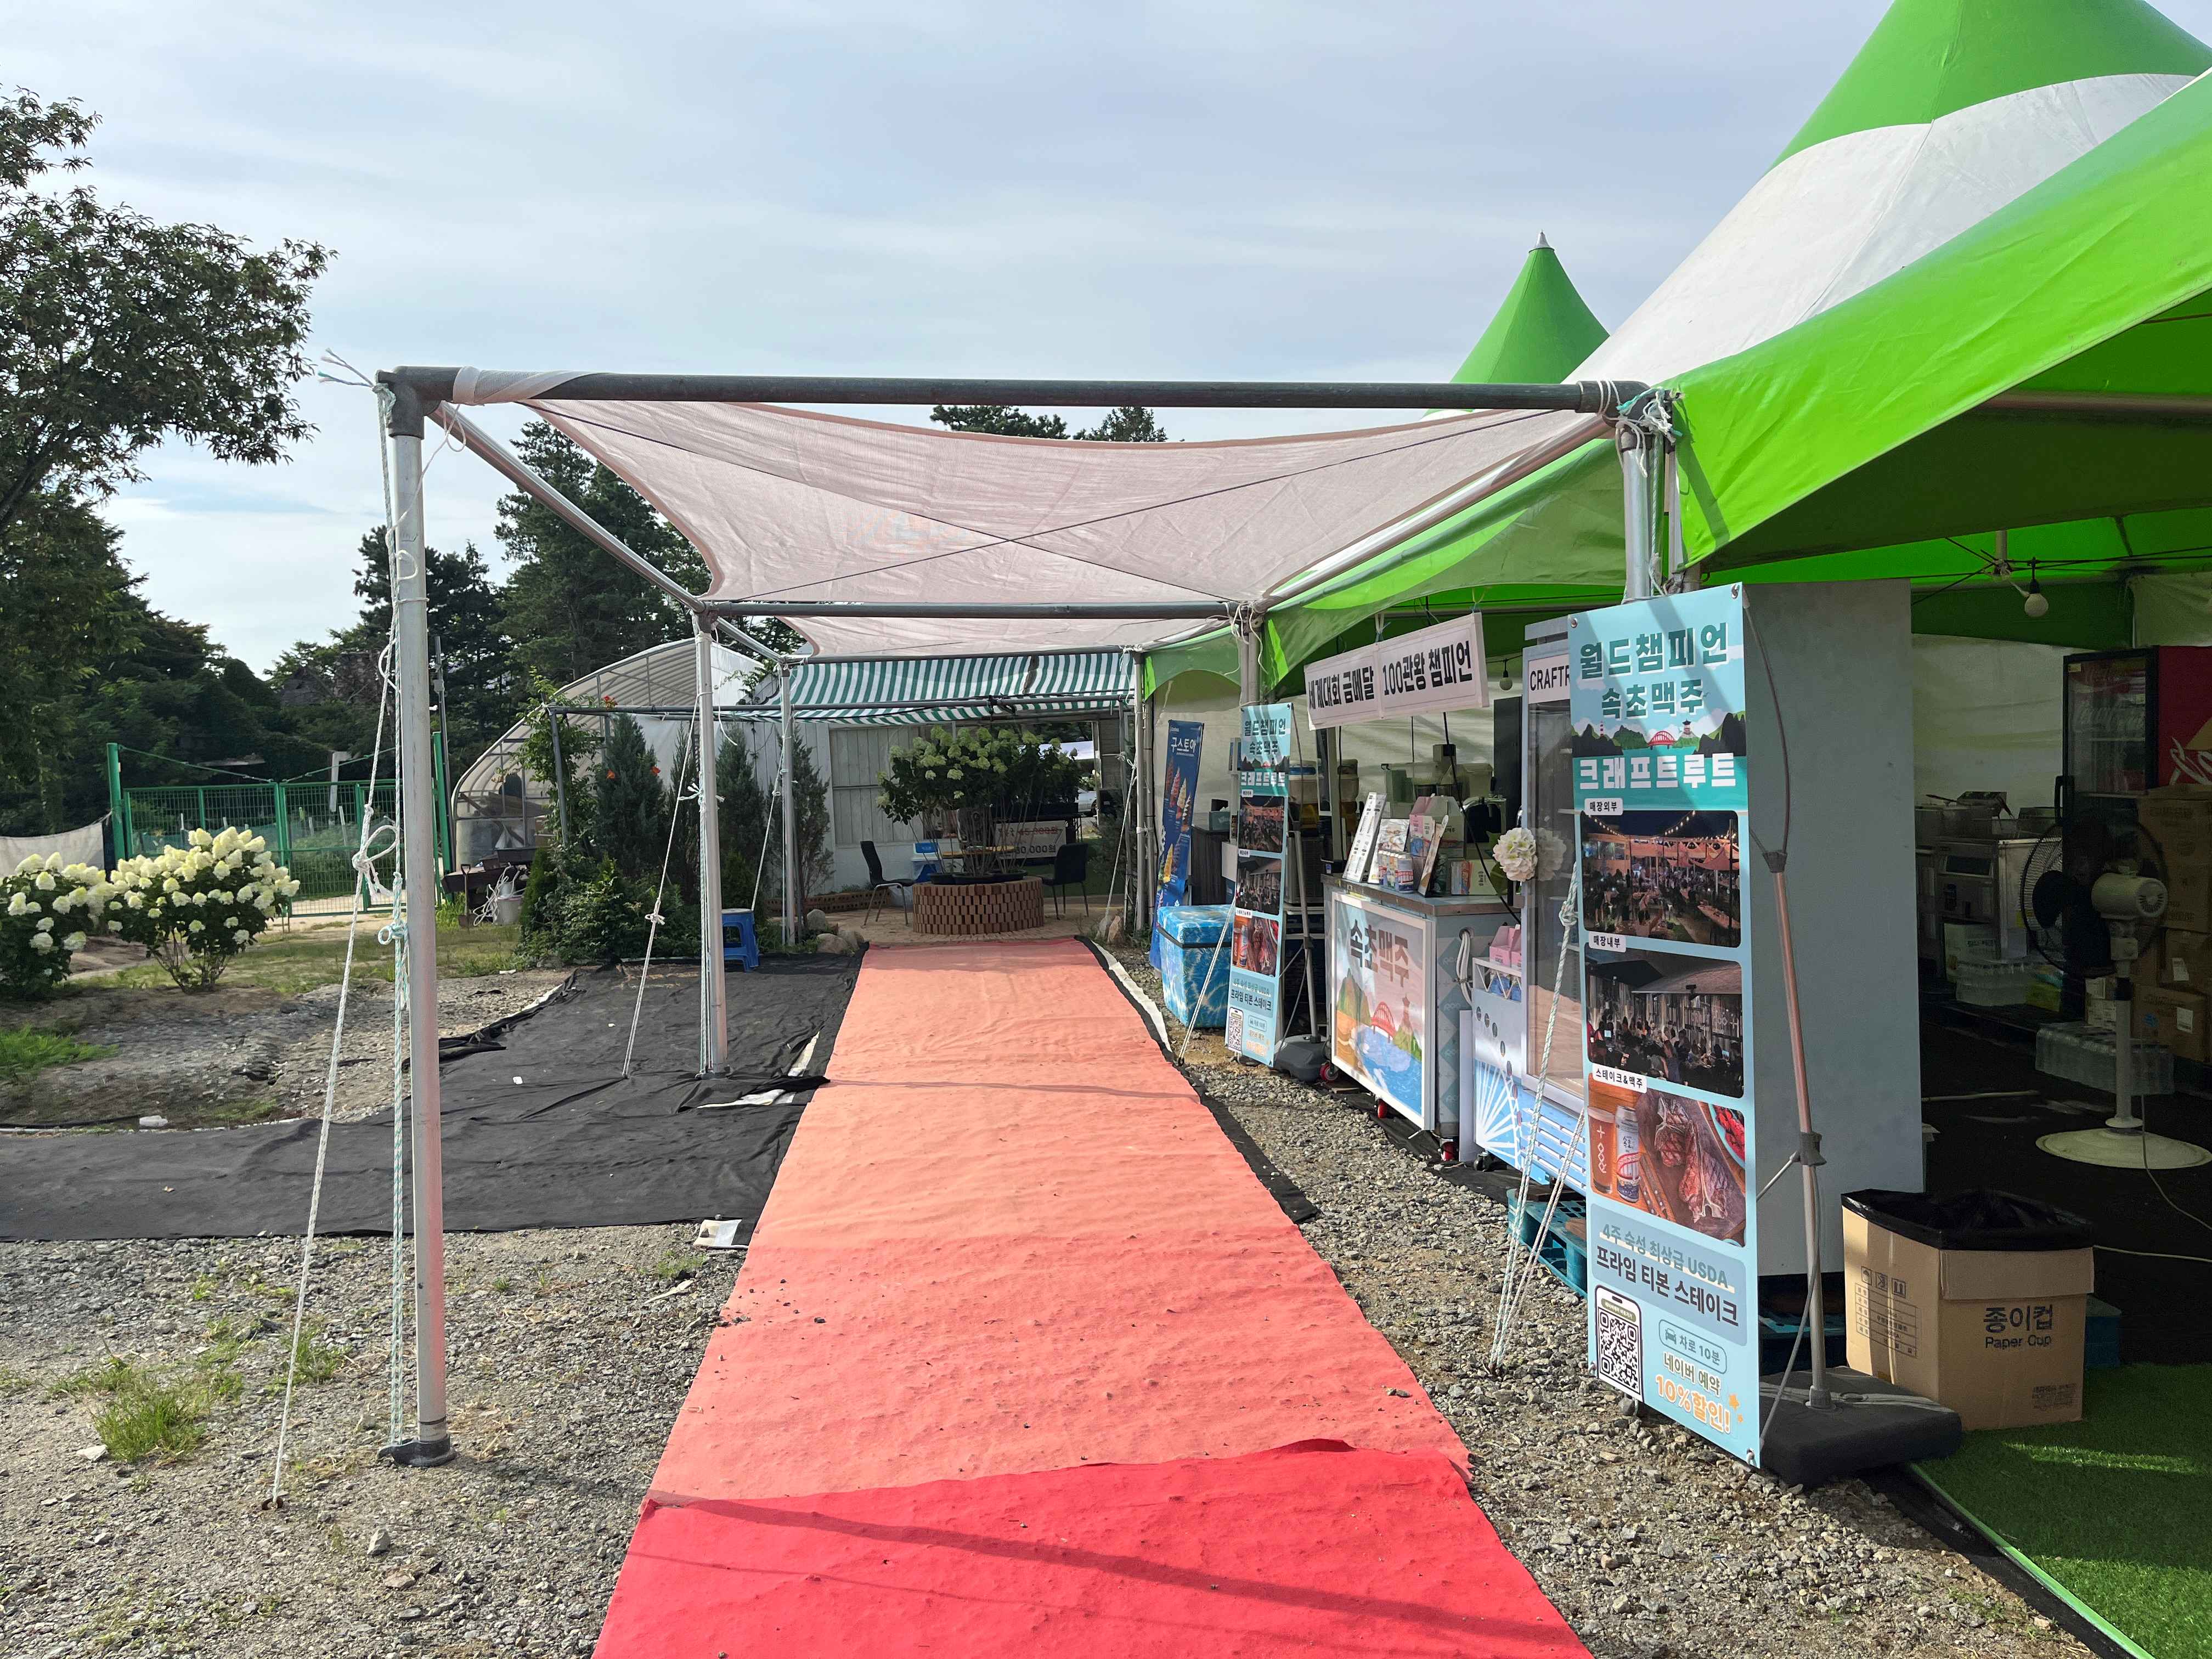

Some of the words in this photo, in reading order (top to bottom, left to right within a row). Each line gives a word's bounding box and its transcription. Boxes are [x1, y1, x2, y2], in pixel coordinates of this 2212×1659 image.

[1580, 622, 1729, 681] 월드챔피언
[1308, 678, 1342, 710] 세계대회
[1342, 665, 1375, 704] 금메달
[1382, 651, 1426, 696] 100관왕
[1429, 640, 1473, 689] 챔피언
[1601, 679, 1704, 720] 속초맥주
[1244, 718, 1286, 736] 월드챔피언
[1249, 740, 1278, 755] 속초맥주
[1240, 772, 1286, 787] 크래프트루트
[1579, 752, 1736, 791] 크래프트루트
[1589, 800, 1617, 812] 매장외부
[1350, 919, 1409, 988] 속초맥주
[1593, 935, 1621, 948] 매장내부
[1596, 1069, 1643, 1089] 스테이크&맥주
[1602, 1223, 1621, 1243] 4주
[1624, 1230, 1647, 1256] 숙성
[1649, 1242, 1685, 1269] 최상급
[1687, 1256, 1729, 1288] USDA
[1596, 1245, 1637, 1283] 프라임
[1641, 1263, 1670, 1298] 티본
[1674, 1280, 1739, 1327] 스테이크
[1983, 1304, 2053, 1334] 종이컵
[1679, 1334, 1696, 1352] 차로
[1699, 1343, 1721, 1366] 10분
[1985, 1335, 2023, 1350] Paper
[2028, 1334, 2052, 1347] Cup
[1663, 1352, 1695, 1381] 네이버
[1698, 1368, 1722, 1395] 예약
[1655, 1375, 1731, 1433] 10%할인!
